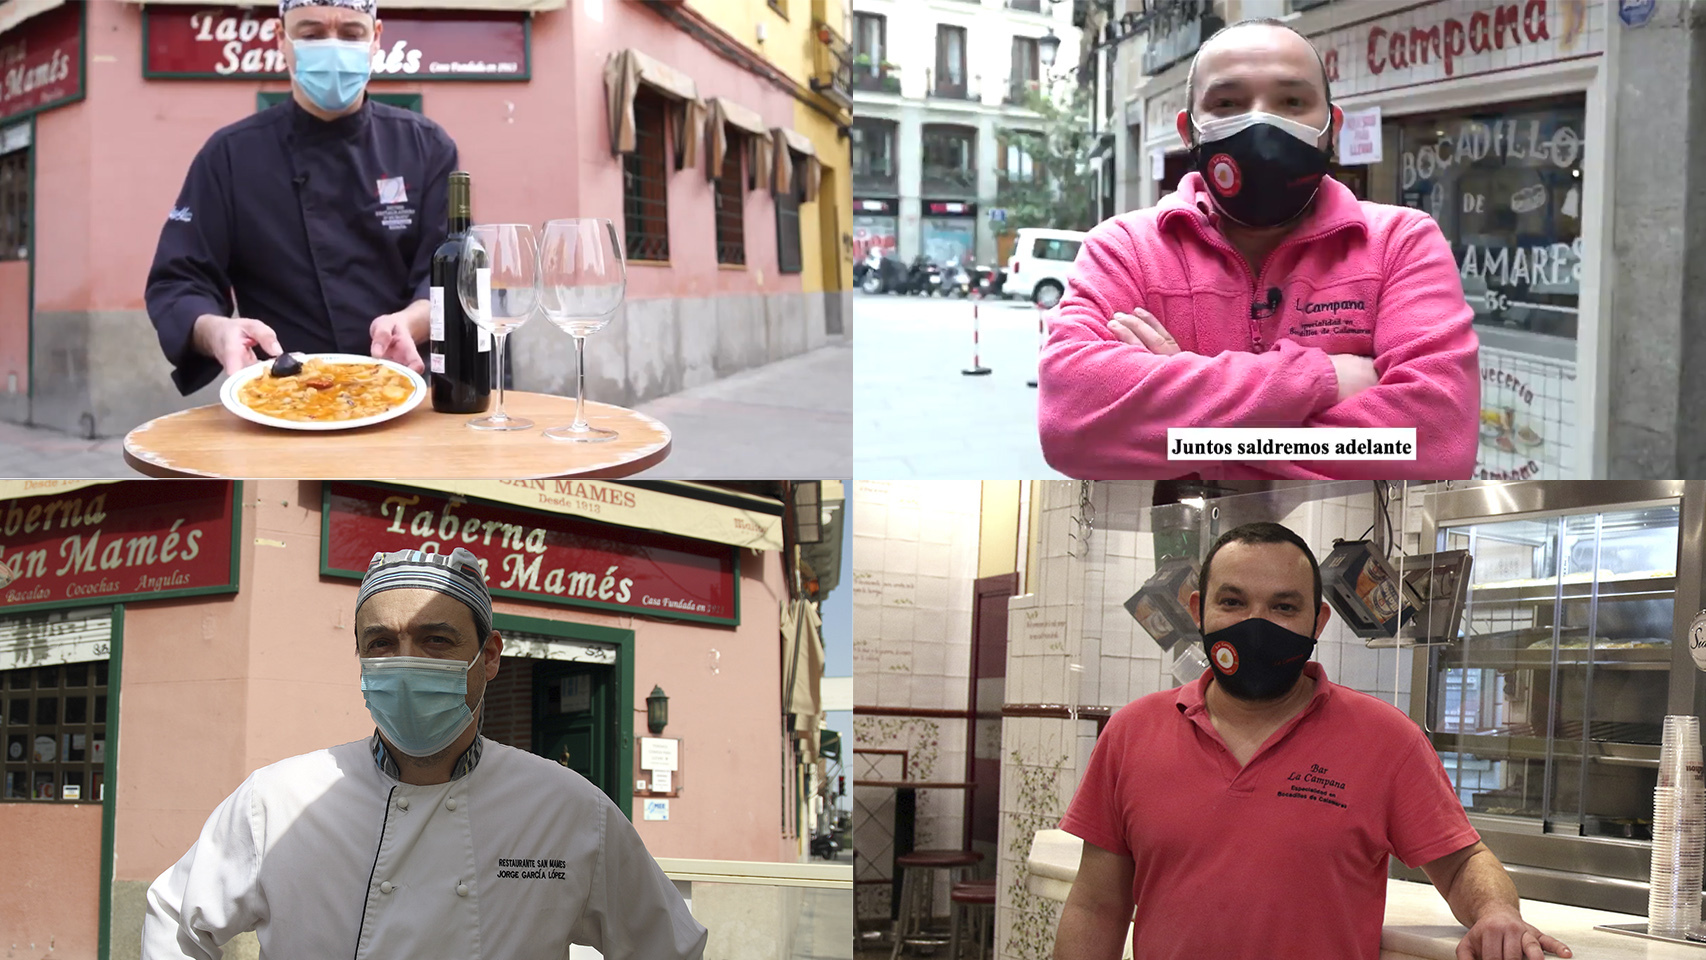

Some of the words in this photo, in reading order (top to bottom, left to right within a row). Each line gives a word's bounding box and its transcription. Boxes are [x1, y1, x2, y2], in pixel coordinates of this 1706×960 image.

[190, 9, 280, 42] Tabe
[1367, 0, 1549, 75] Campana
[1402, 118, 1585, 190] BOCADILLO
[1463, 192, 1485, 214] DE
[1304, 300, 1365, 315] Campana
[1302, 318, 1341, 330] specialidad
[538, 492, 572, 508] Desde
[576, 500, 601, 514] 1913
[555, 480, 636, 509] MAMES
[0, 492, 107, 537] berna
[380, 495, 548, 554] Taberna
[0, 545, 47, 580] an
[55, 518, 203, 577] Mamés
[5, 584, 51, 602] Bacalao
[66, 577, 120, 598] Cocochas
[135, 569, 191, 592] Angulas
[500, 554, 634, 604] Mamés
[642, 594, 661, 606] Casa
[662, 597, 696, 611] Fundada
[696, 603, 706, 613] en
[1310, 763, 1328, 775] Bar
[1287, 771, 1301, 781] La
[1304, 773, 1346, 790] Campana
[1291, 785, 1327, 796] Especialidad
[1277, 791, 1307, 799] Bocadillos
[1319, 796, 1347, 809] Calamares
[497, 870, 519, 879] JORGE
[521, 868, 546, 879] GARCÍA
[548, 868, 566, 880] LÓPEZ
[498, 858, 535, 868] RESTAURANTE
[537, 859, 548, 868] SAN
[549, 859, 566, 869] MAMES
